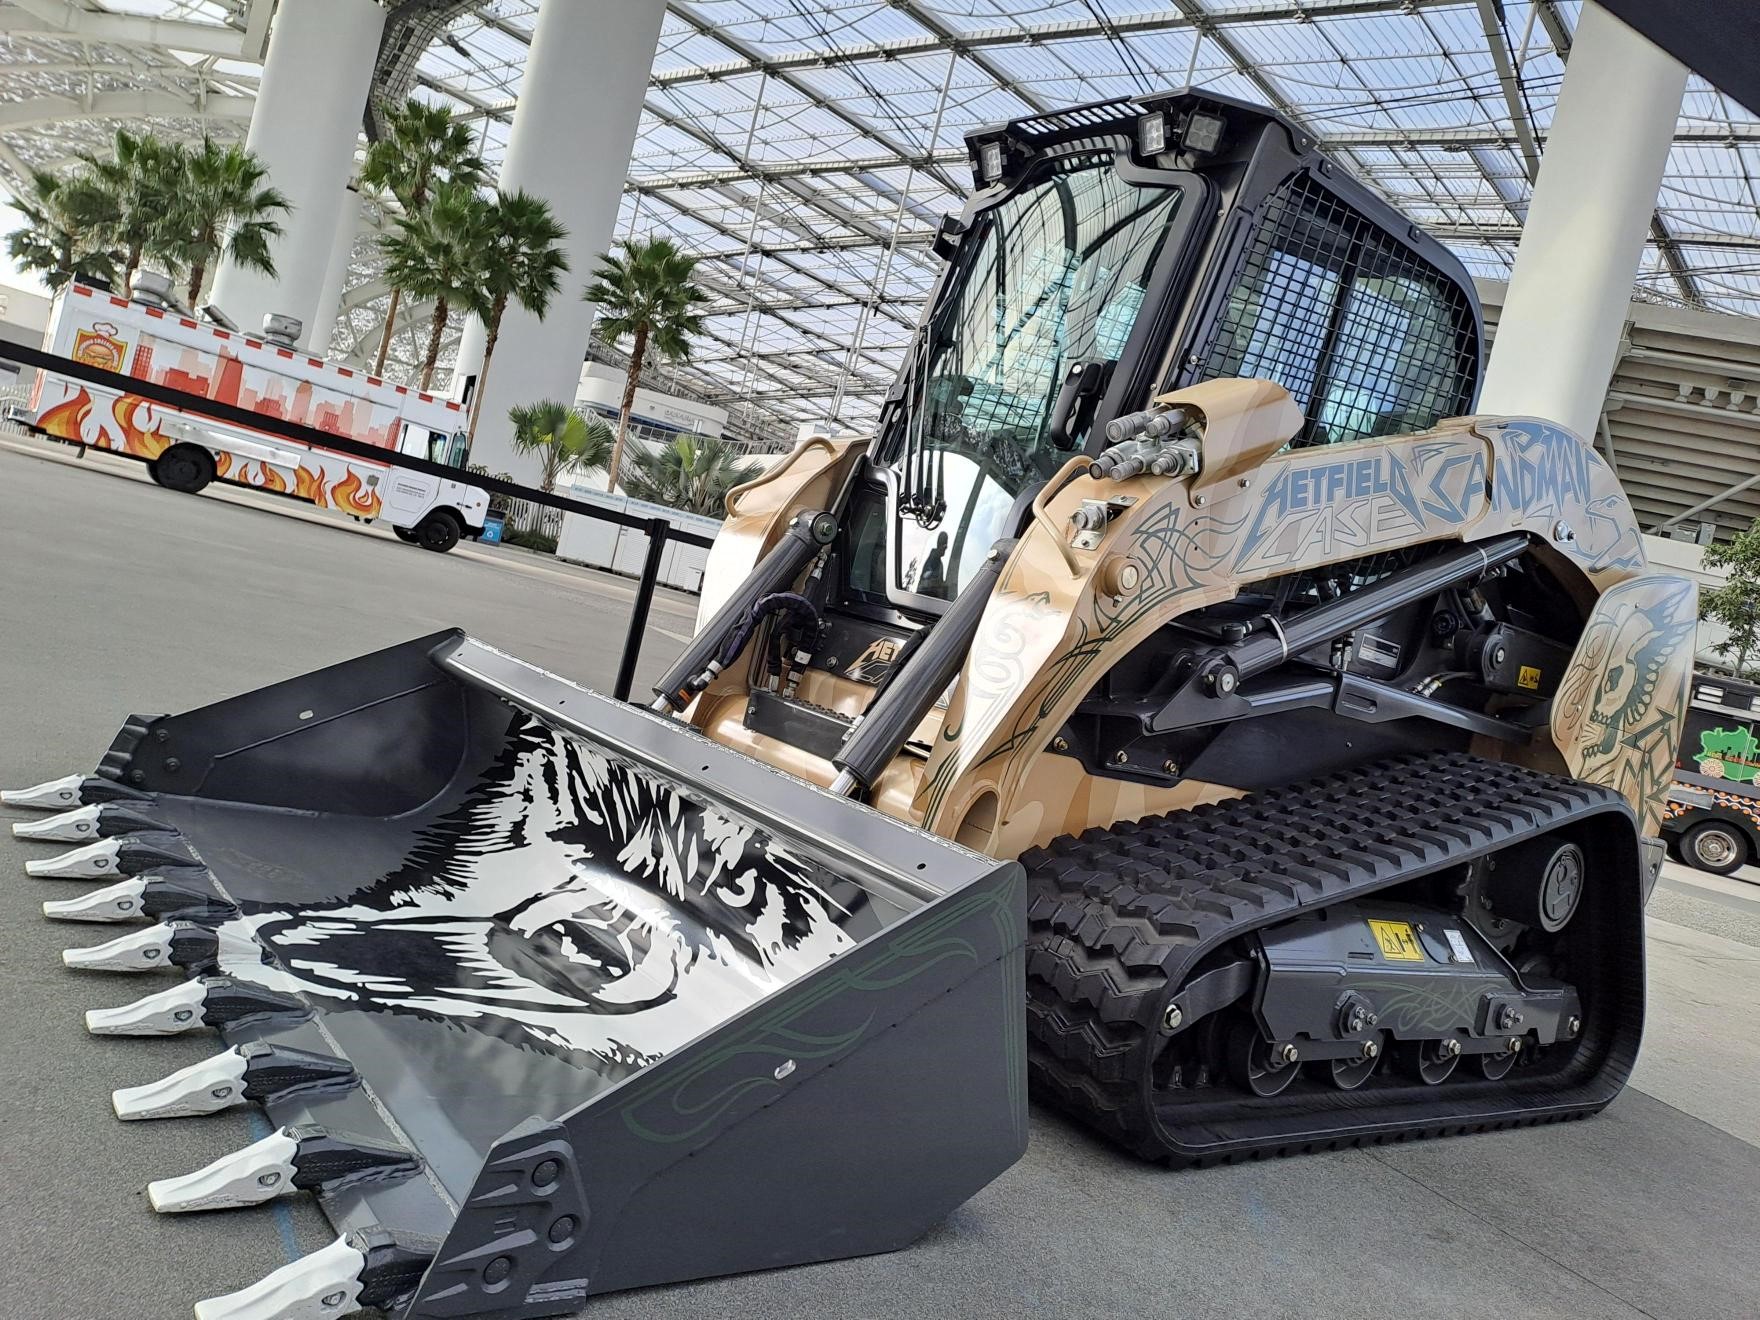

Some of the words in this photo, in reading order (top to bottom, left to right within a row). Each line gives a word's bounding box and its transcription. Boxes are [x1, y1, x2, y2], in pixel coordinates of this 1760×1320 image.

[1231, 447, 1425, 572] HETFIELD
[1421, 421, 1603, 525] SANDMAN
[1236, 493, 1424, 574] CASE
